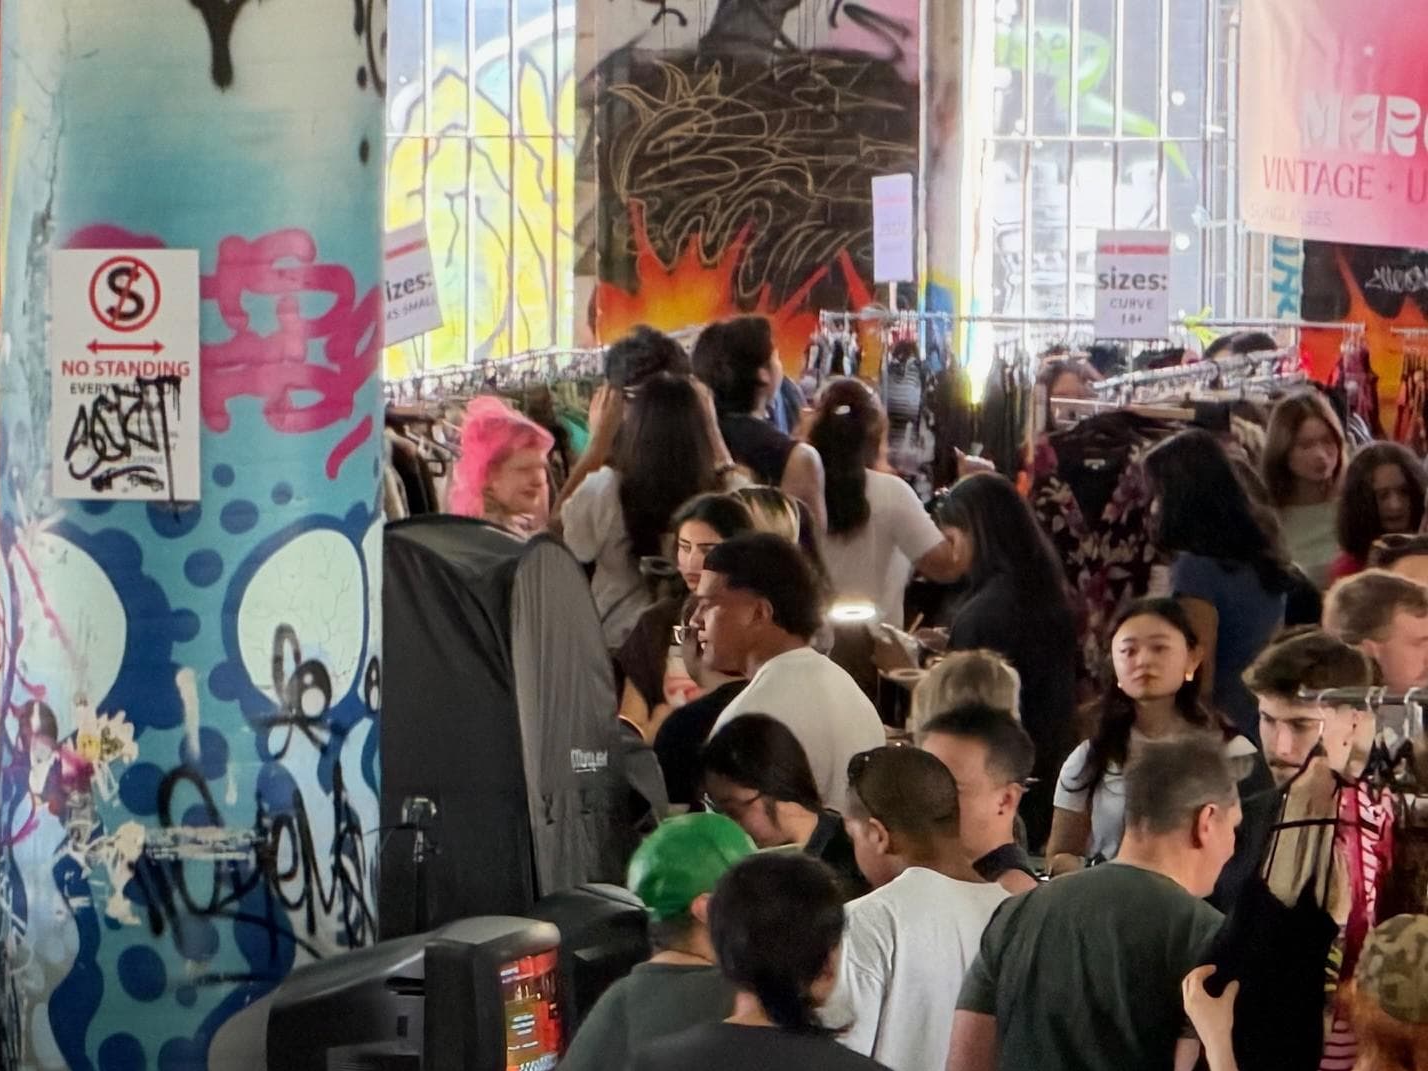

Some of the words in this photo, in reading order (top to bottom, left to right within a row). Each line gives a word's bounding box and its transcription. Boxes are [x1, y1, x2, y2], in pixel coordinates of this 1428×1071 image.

[1262, 155, 1375, 201] VINTAGE
[385, 271, 434, 303] izes:
[1097, 264, 1168, 292] sizes:
[61, 359, 90, 377] NO
[94, 359, 191, 378] STANDING
